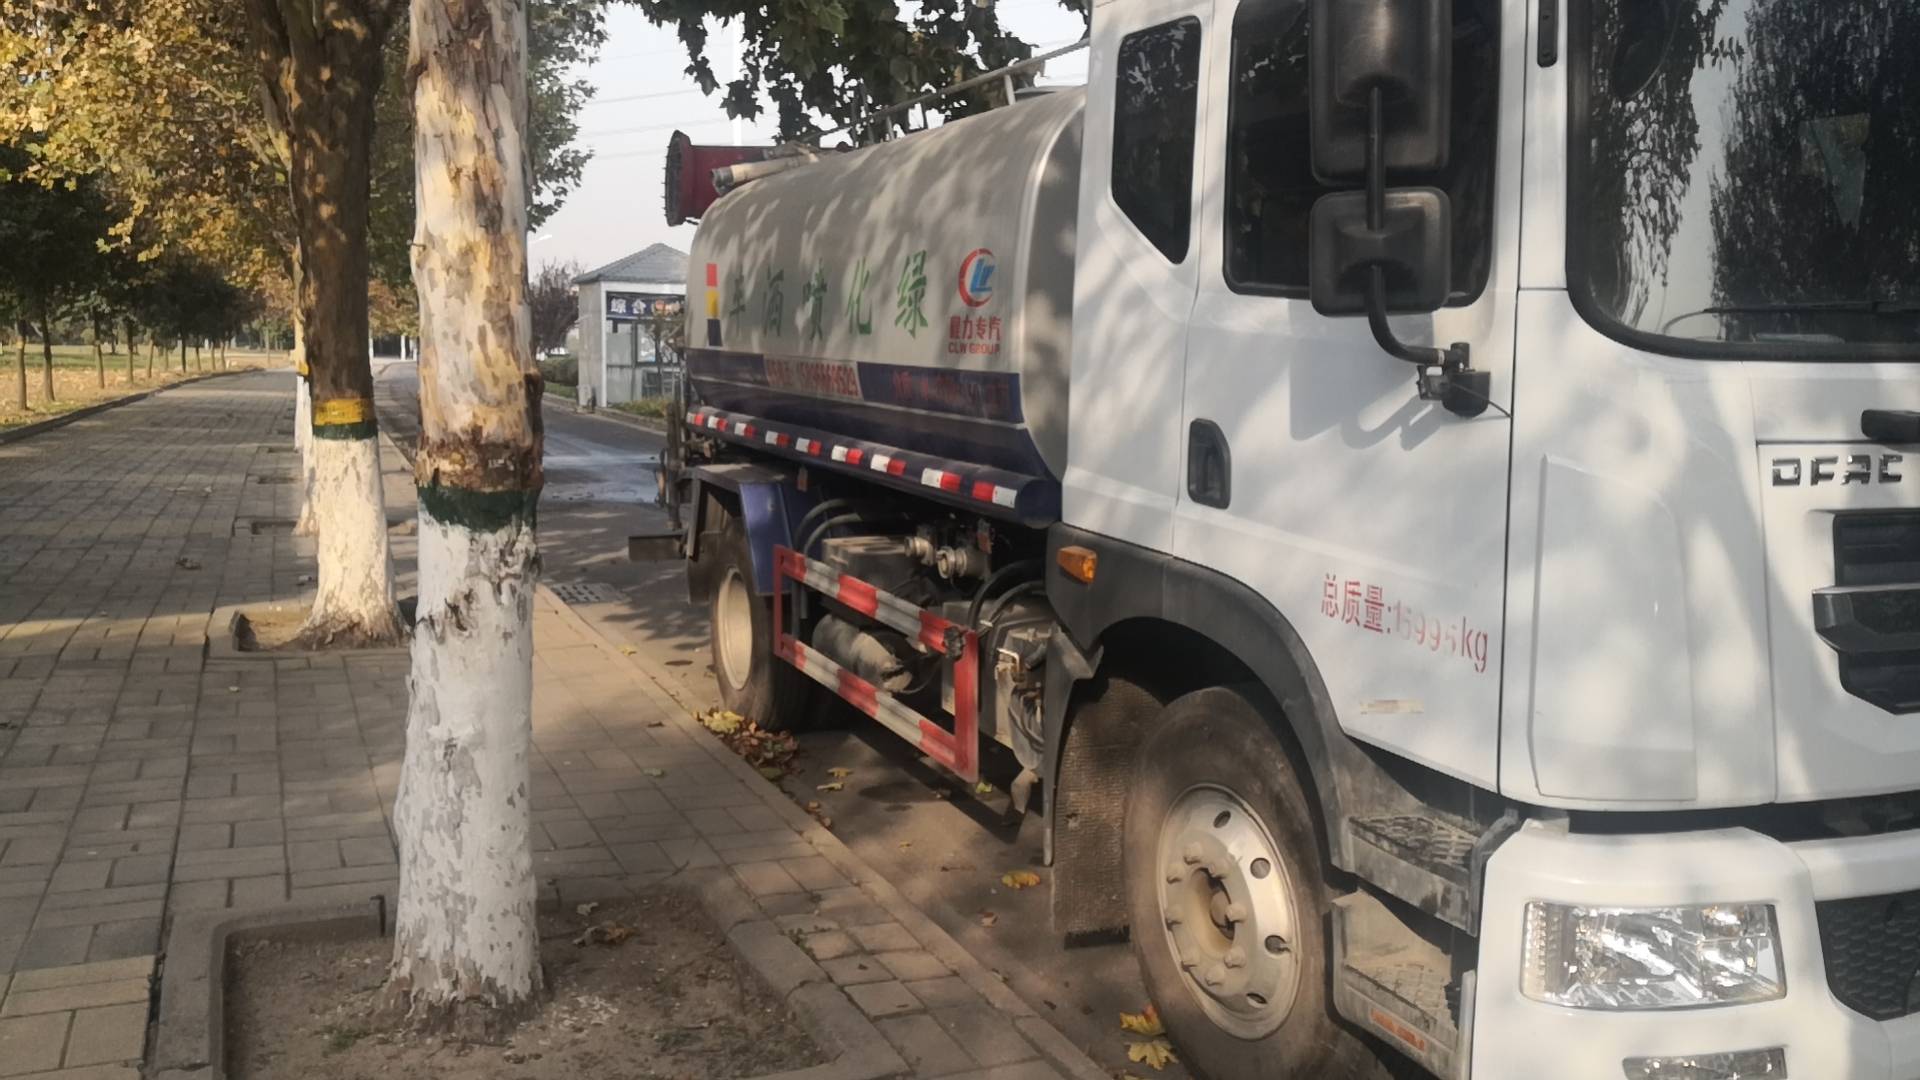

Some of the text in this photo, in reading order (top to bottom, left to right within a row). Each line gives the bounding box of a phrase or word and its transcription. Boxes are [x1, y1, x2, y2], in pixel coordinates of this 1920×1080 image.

[948, 342, 1000, 356] CLW GROUP
[1772, 453, 1904, 487] DFAC
